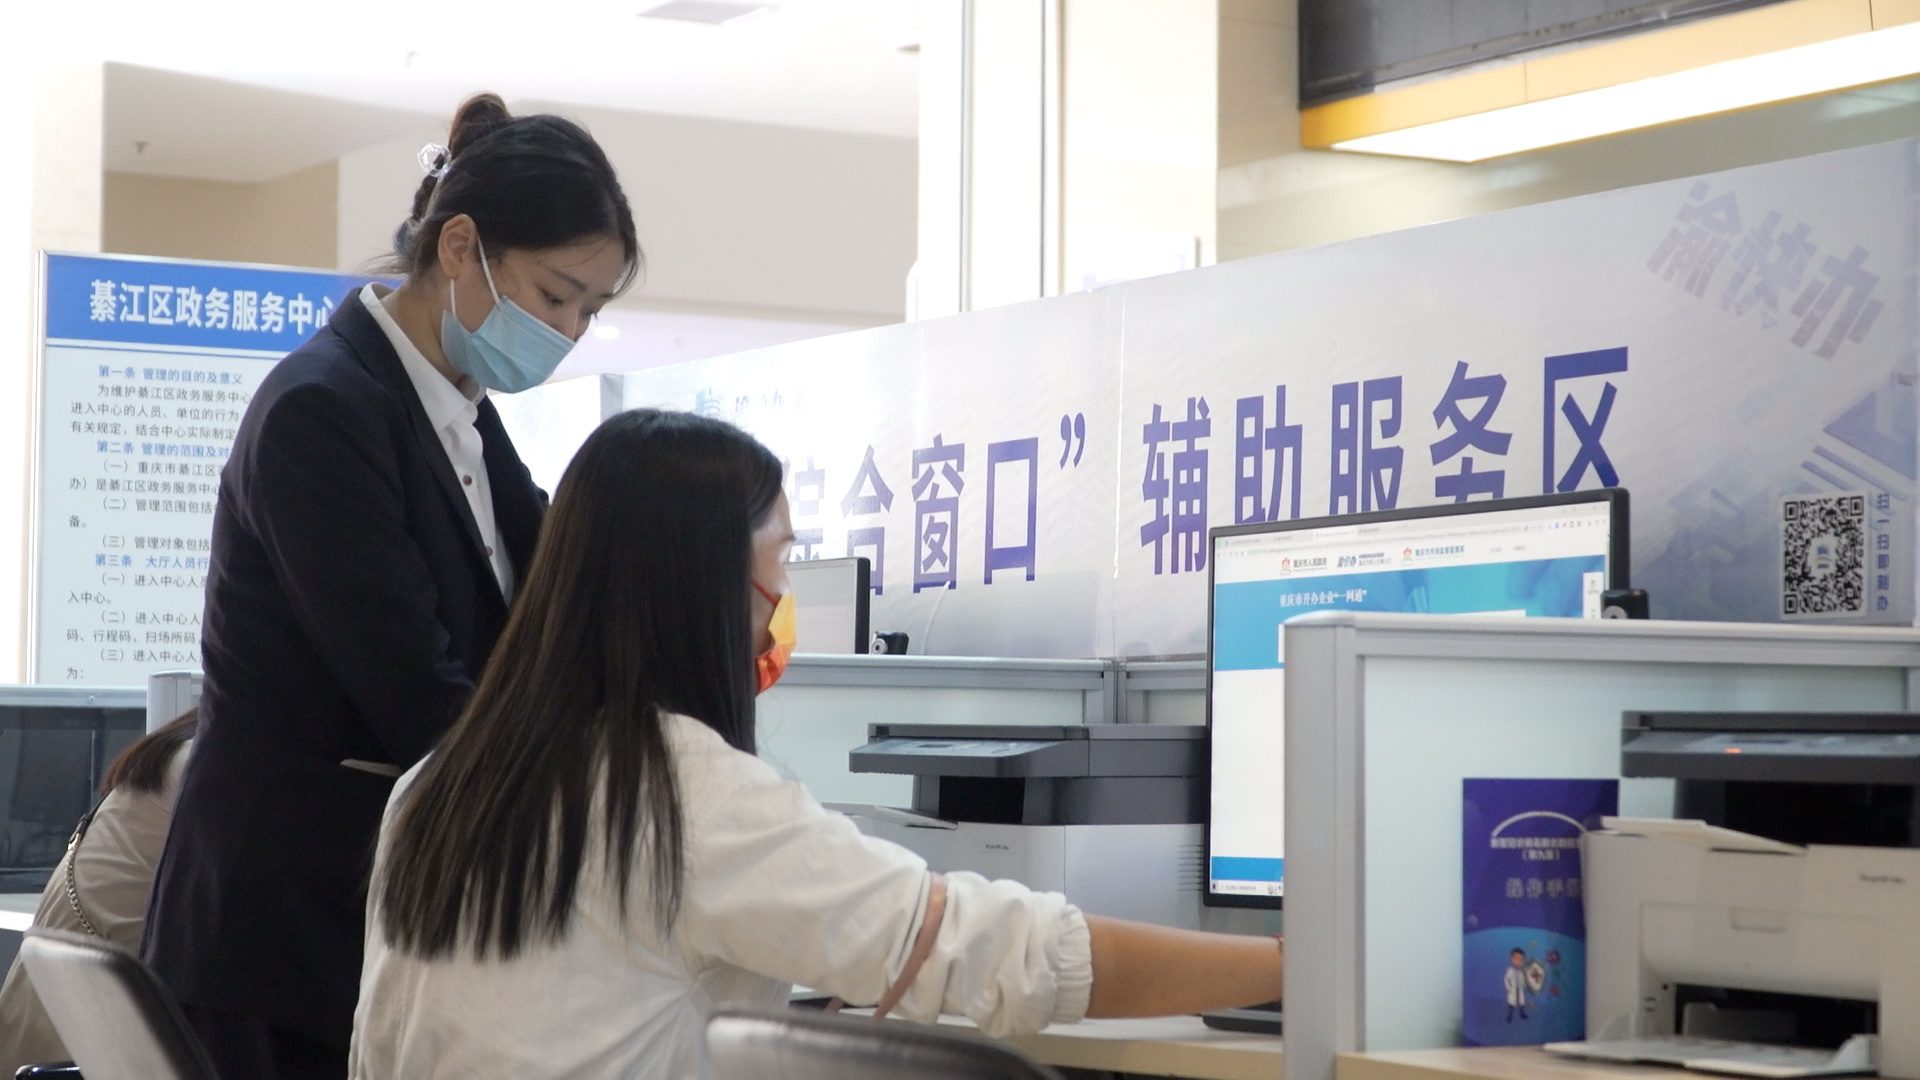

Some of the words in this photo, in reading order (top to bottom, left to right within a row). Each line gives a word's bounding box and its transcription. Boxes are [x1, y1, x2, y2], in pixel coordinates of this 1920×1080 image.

[1647, 179, 1886, 360] 渝快办
[98, 365, 135, 379] 第一条
[142, 368, 243, 385] 管理的目的及意义
[70, 401, 239, 422] 进入中心的人员、单位的行为
[97, 441, 134, 455] 第二条
[103, 461, 222, 477] （一）重庆市綦江区
[1141, 346, 1629, 575] 辅助服务区
[102, 498, 216, 514] （二）管理范围包括
[95, 553, 132, 567] 第三条
[146, 555, 208, 570] 大厅人员行
